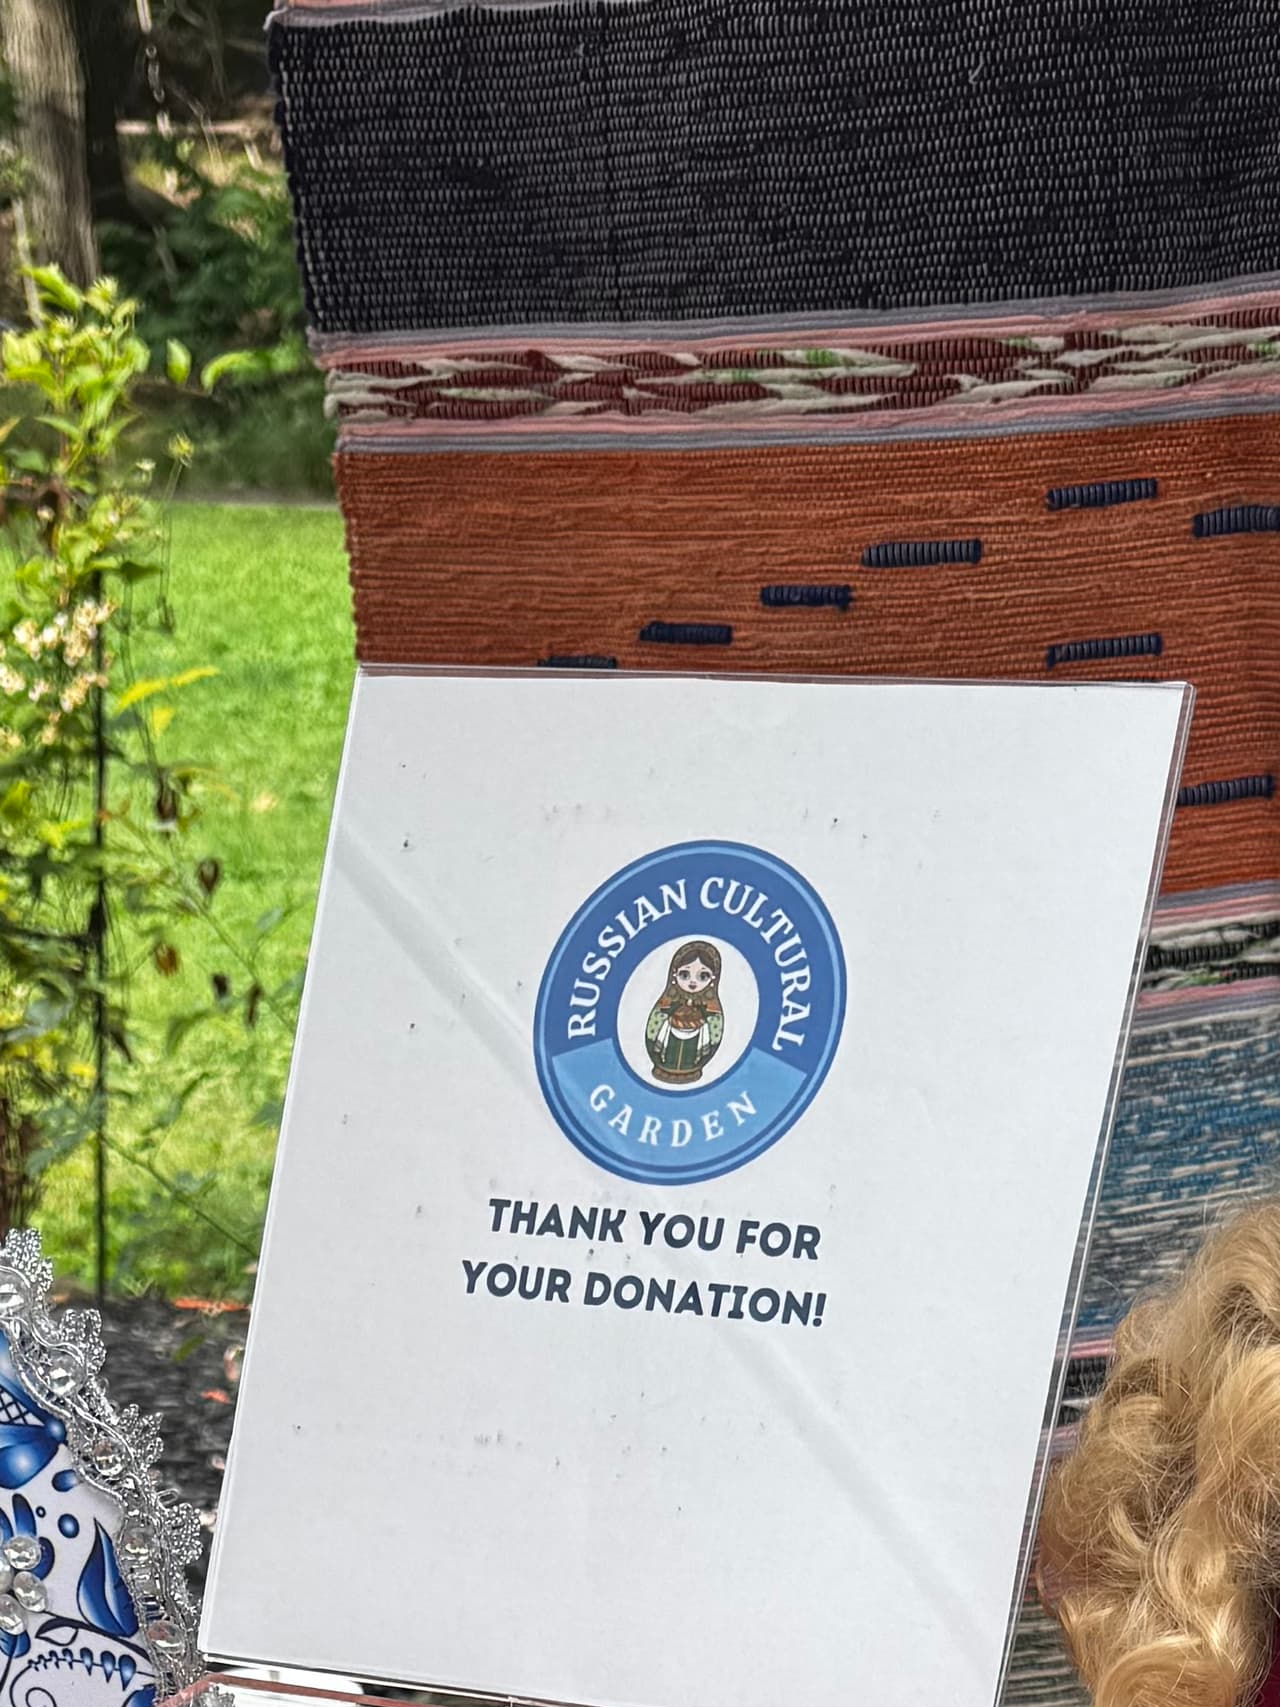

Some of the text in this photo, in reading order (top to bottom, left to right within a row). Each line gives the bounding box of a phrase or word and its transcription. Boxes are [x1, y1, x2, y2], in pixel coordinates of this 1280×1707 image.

[567, 876, 812, 1052] RUSSIAN CULTURAL
[589, 1083, 758, 1148] GARDEN
[489, 1198, 822, 1261] THANK YOU FOR
[461, 1259, 827, 1328] YOUR DONATION!
